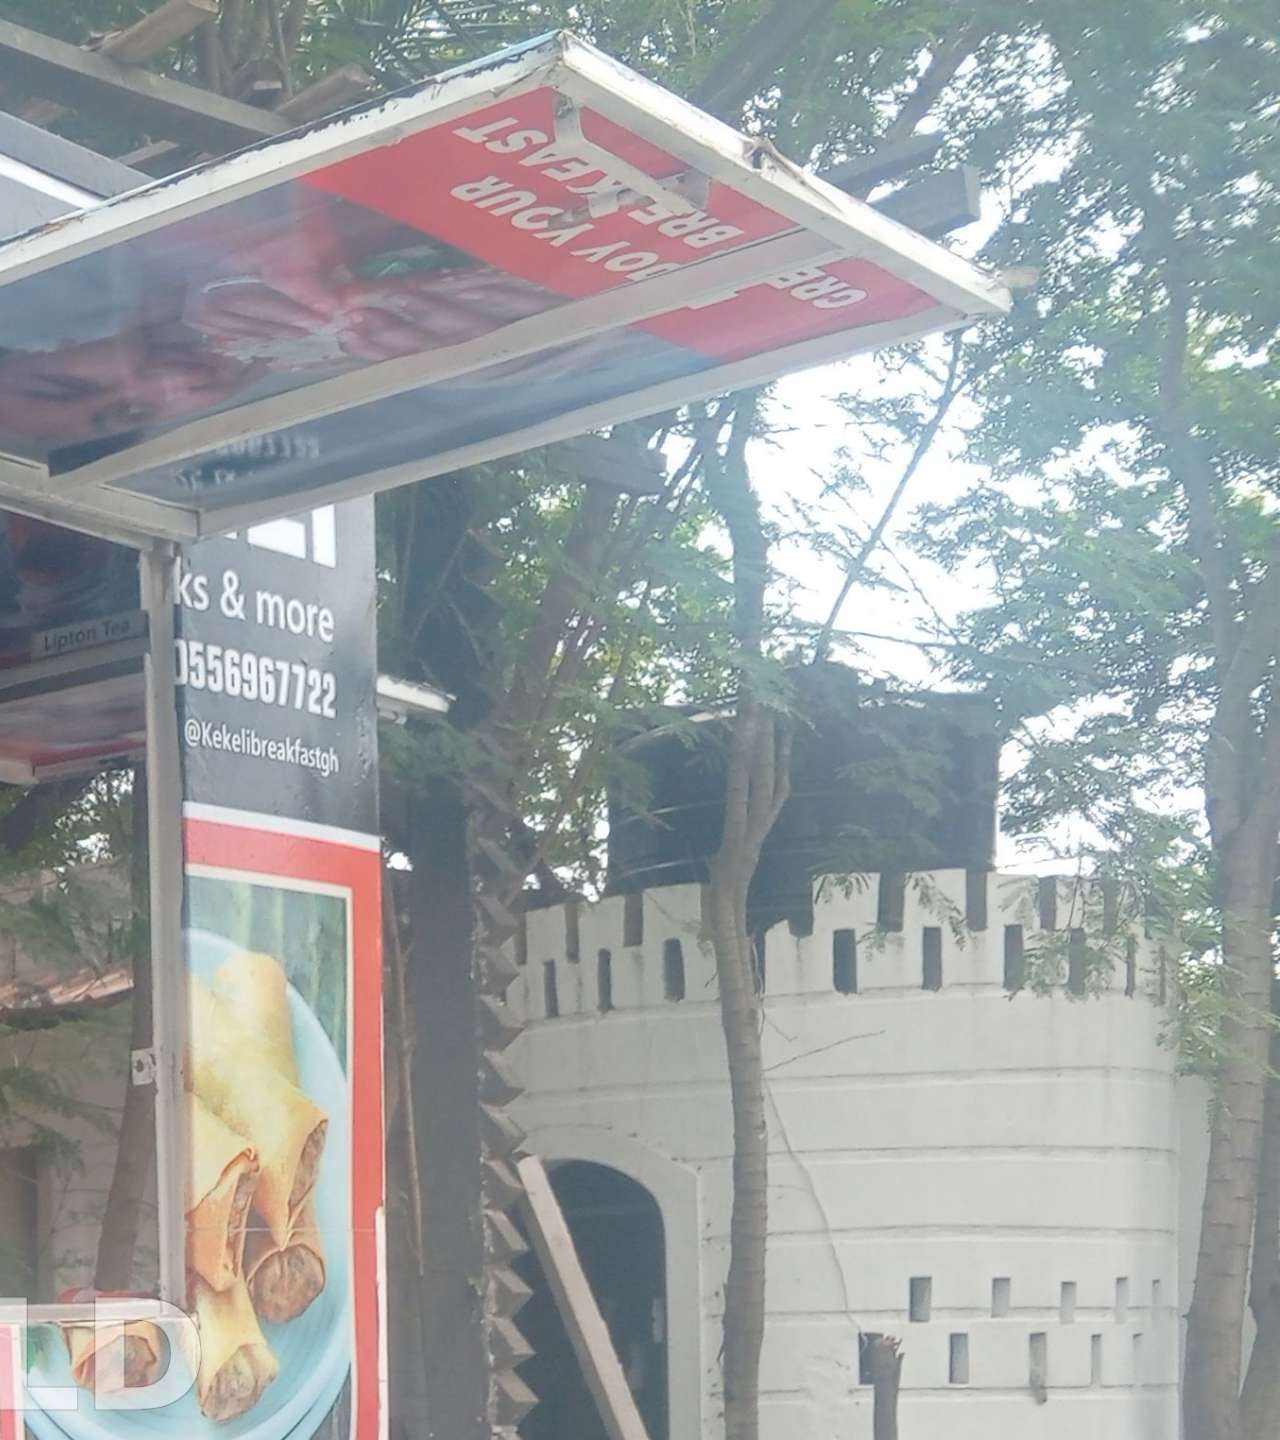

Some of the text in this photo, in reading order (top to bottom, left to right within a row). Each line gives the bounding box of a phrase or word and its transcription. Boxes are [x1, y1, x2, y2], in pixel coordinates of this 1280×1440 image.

[220, 569, 246, 620] &
[255, 589, 335, 643] more
[42, 617, 132, 655] Lipton Tea
[184, 718, 340, 777] @Kekelibreakfastgh
